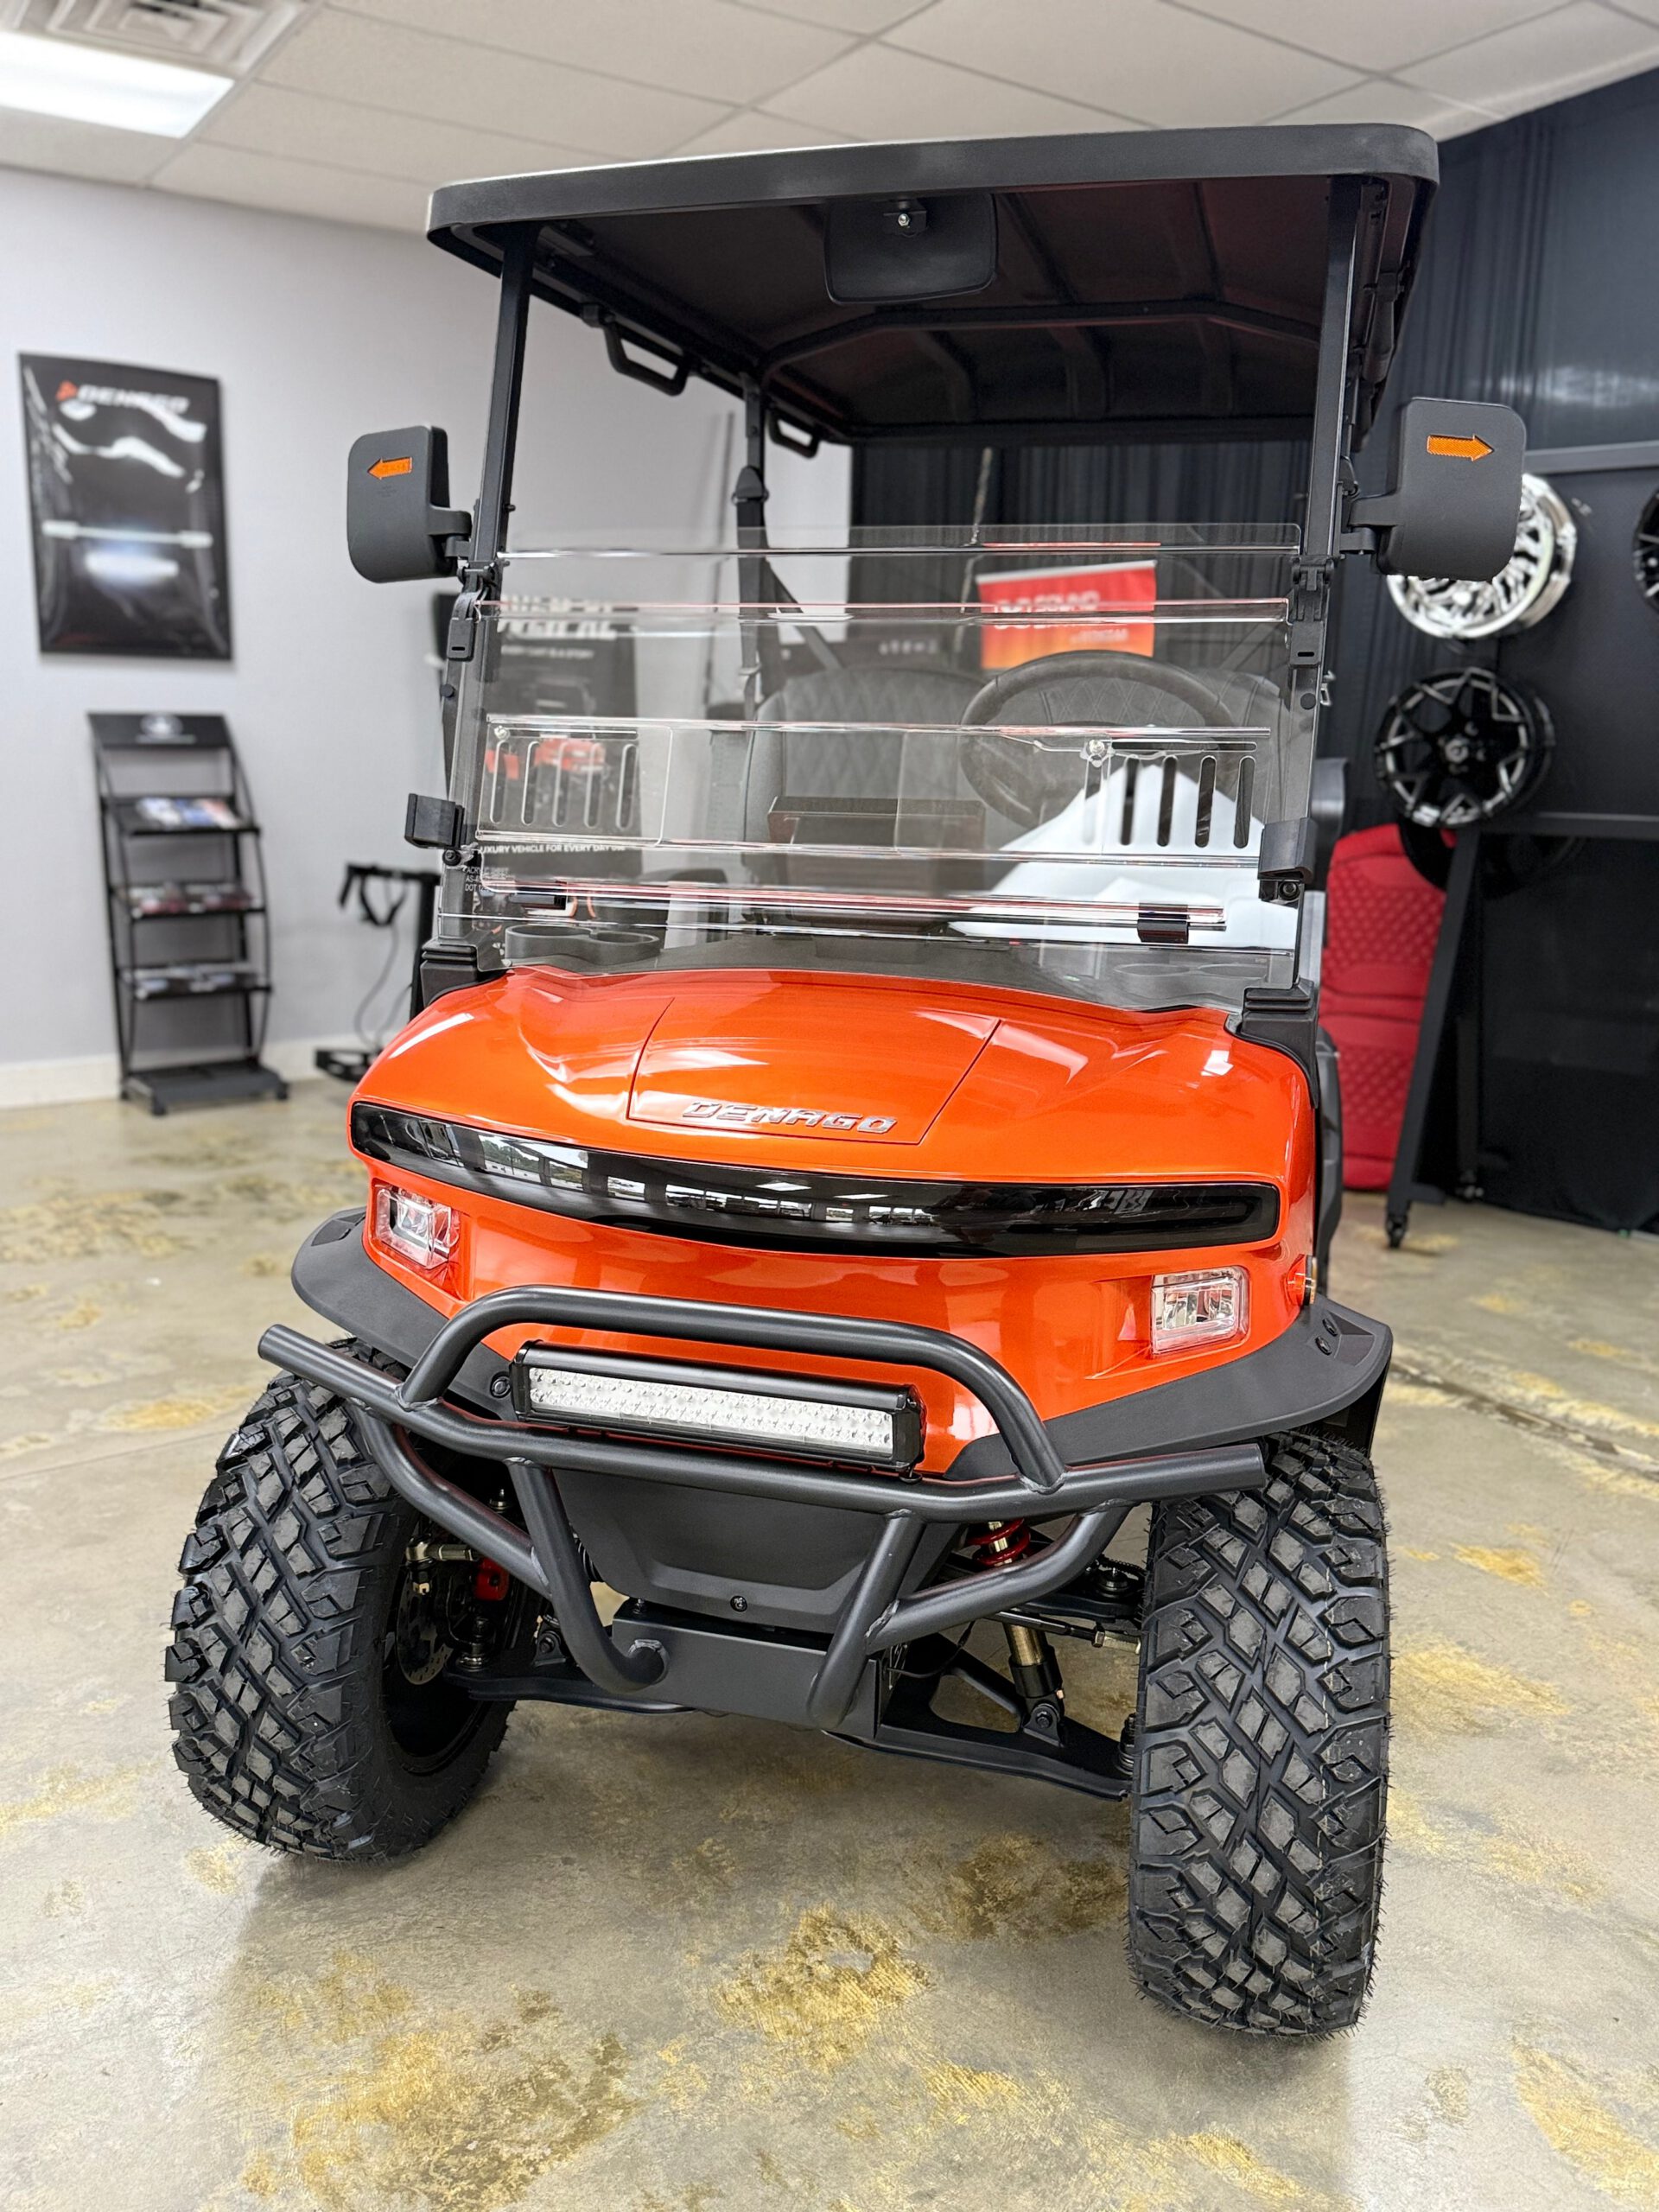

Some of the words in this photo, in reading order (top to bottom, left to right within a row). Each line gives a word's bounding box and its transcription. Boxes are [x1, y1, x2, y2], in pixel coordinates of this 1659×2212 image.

[545, 844, 563, 853] FOR
[563, 844, 592, 853] EVERY
[682, 1101, 898, 1134] DENAGO
